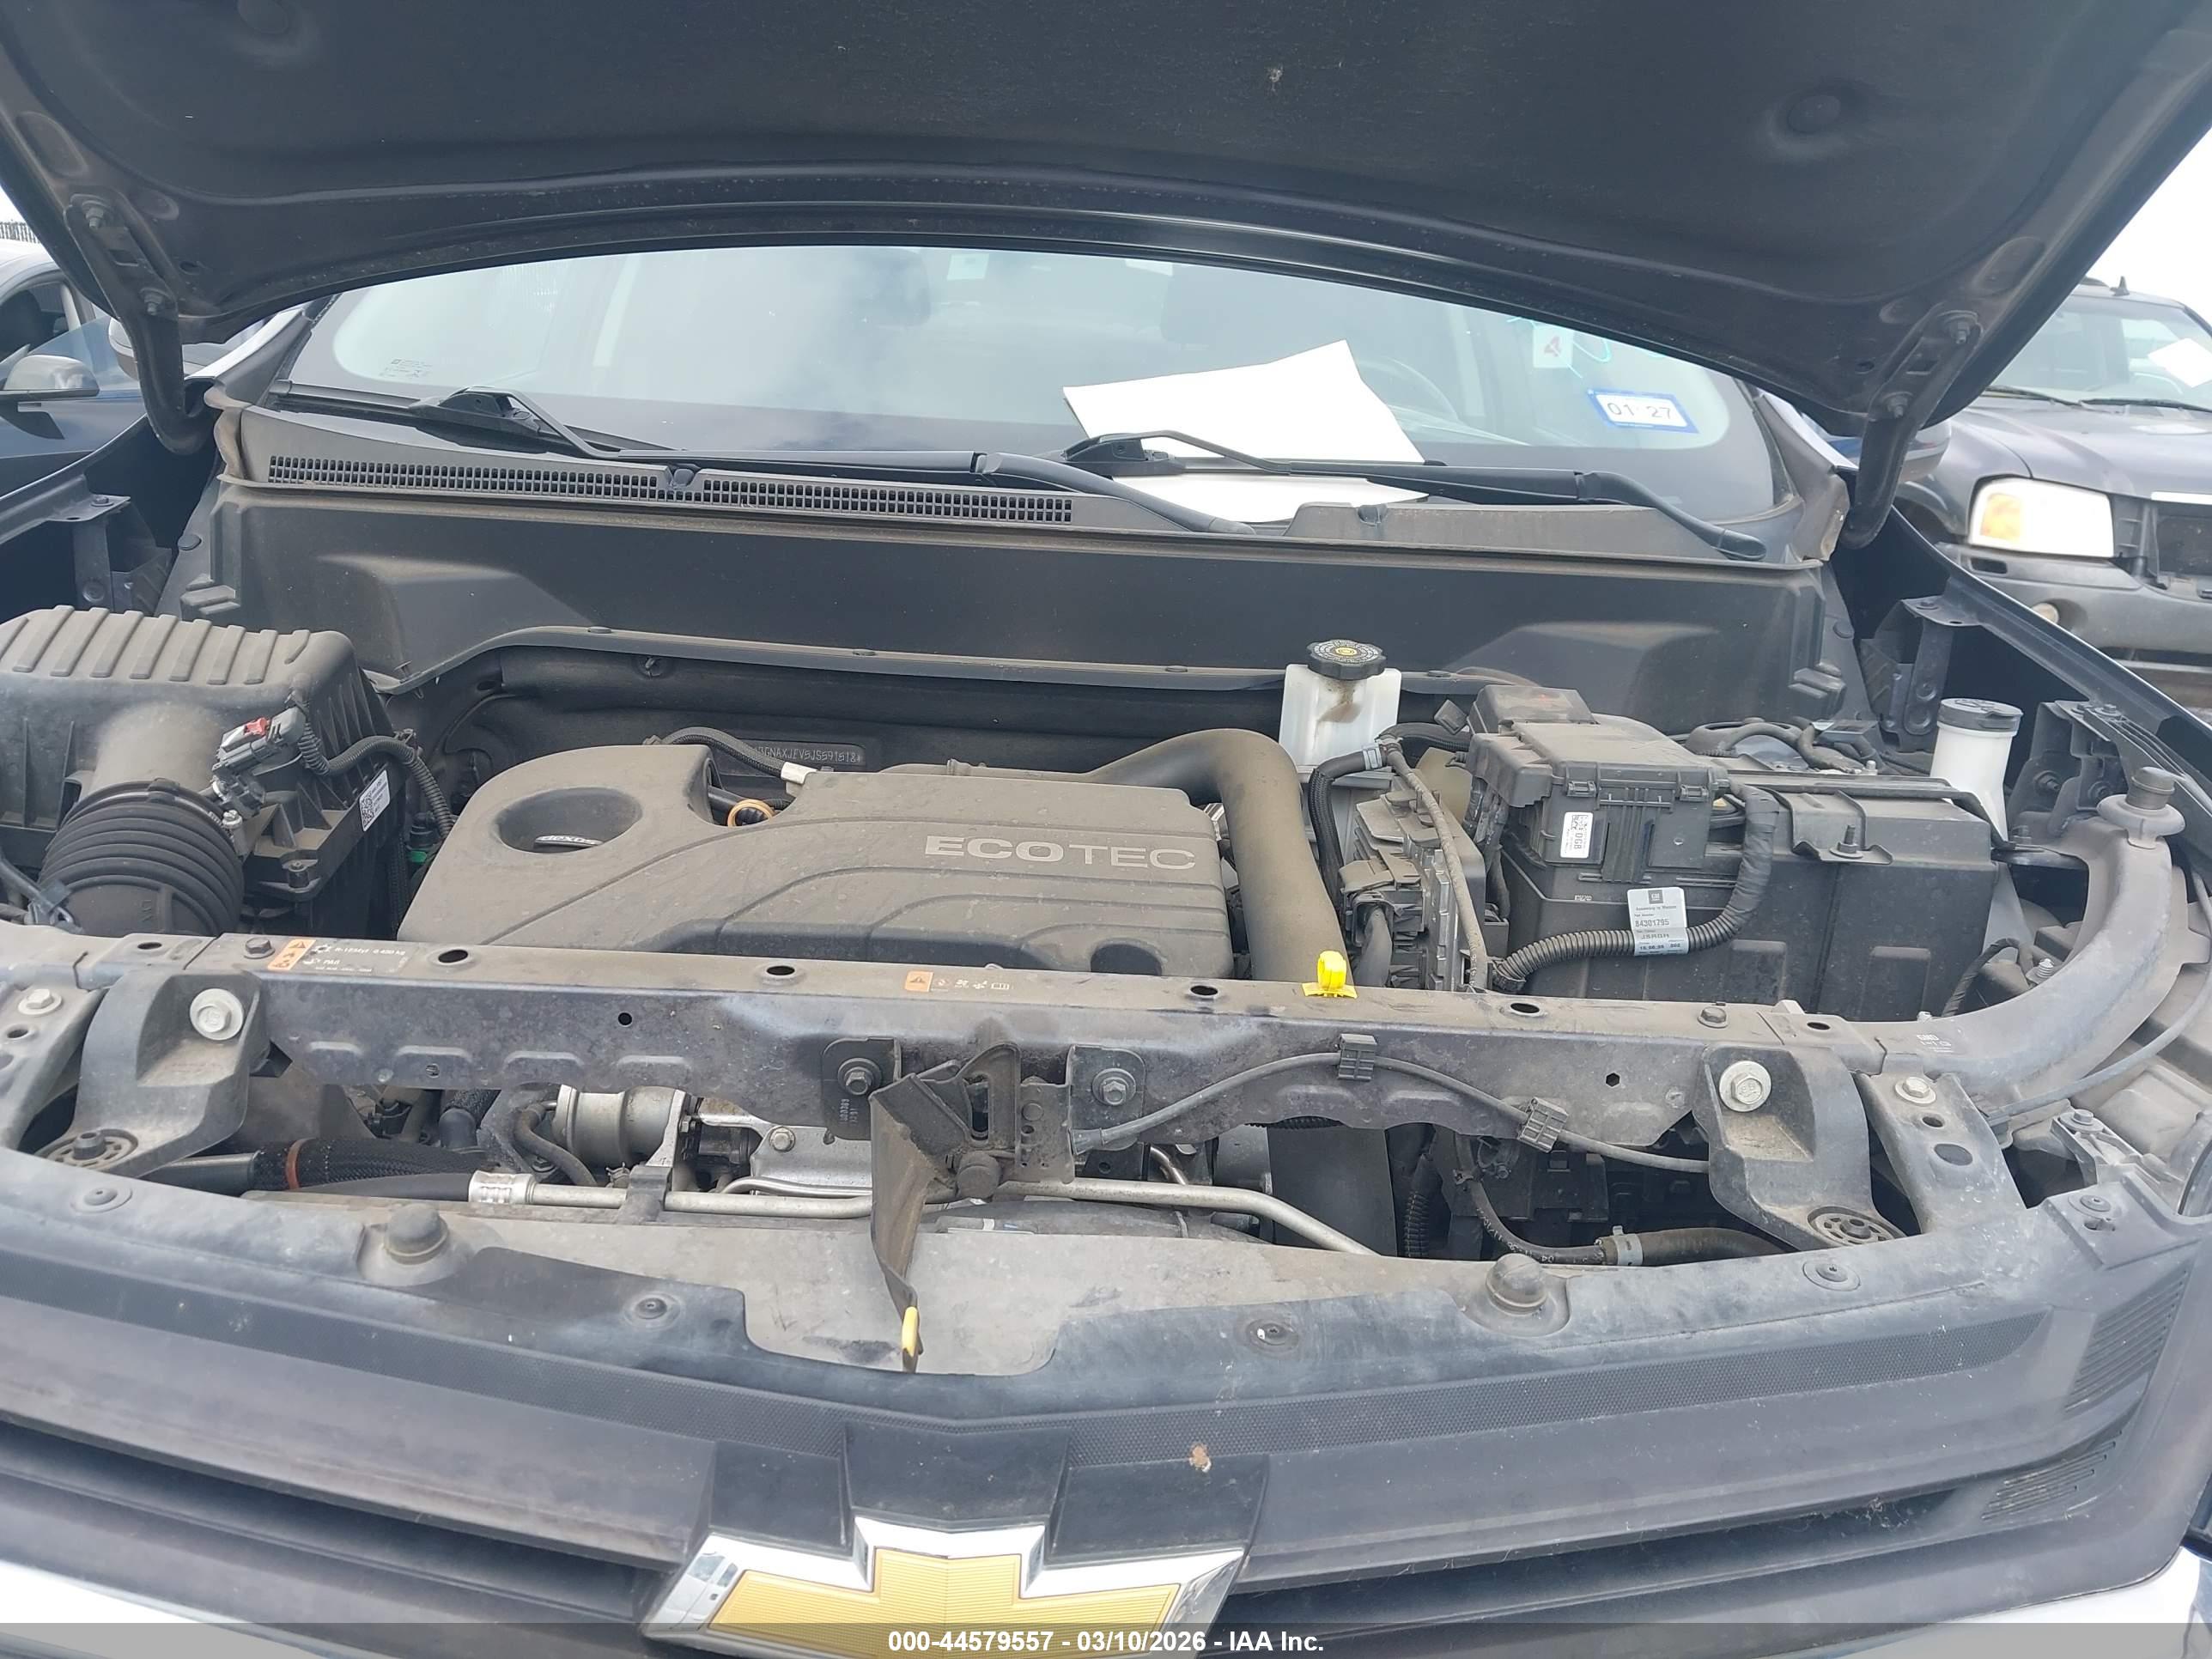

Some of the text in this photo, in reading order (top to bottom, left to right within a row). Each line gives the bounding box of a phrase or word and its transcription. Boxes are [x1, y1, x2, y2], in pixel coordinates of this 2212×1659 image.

[1607, 402, 1671, 419] 01 27
[925, 835, 1196, 870] ECOTEC
[1634, 918, 1670, 927] 84301795
